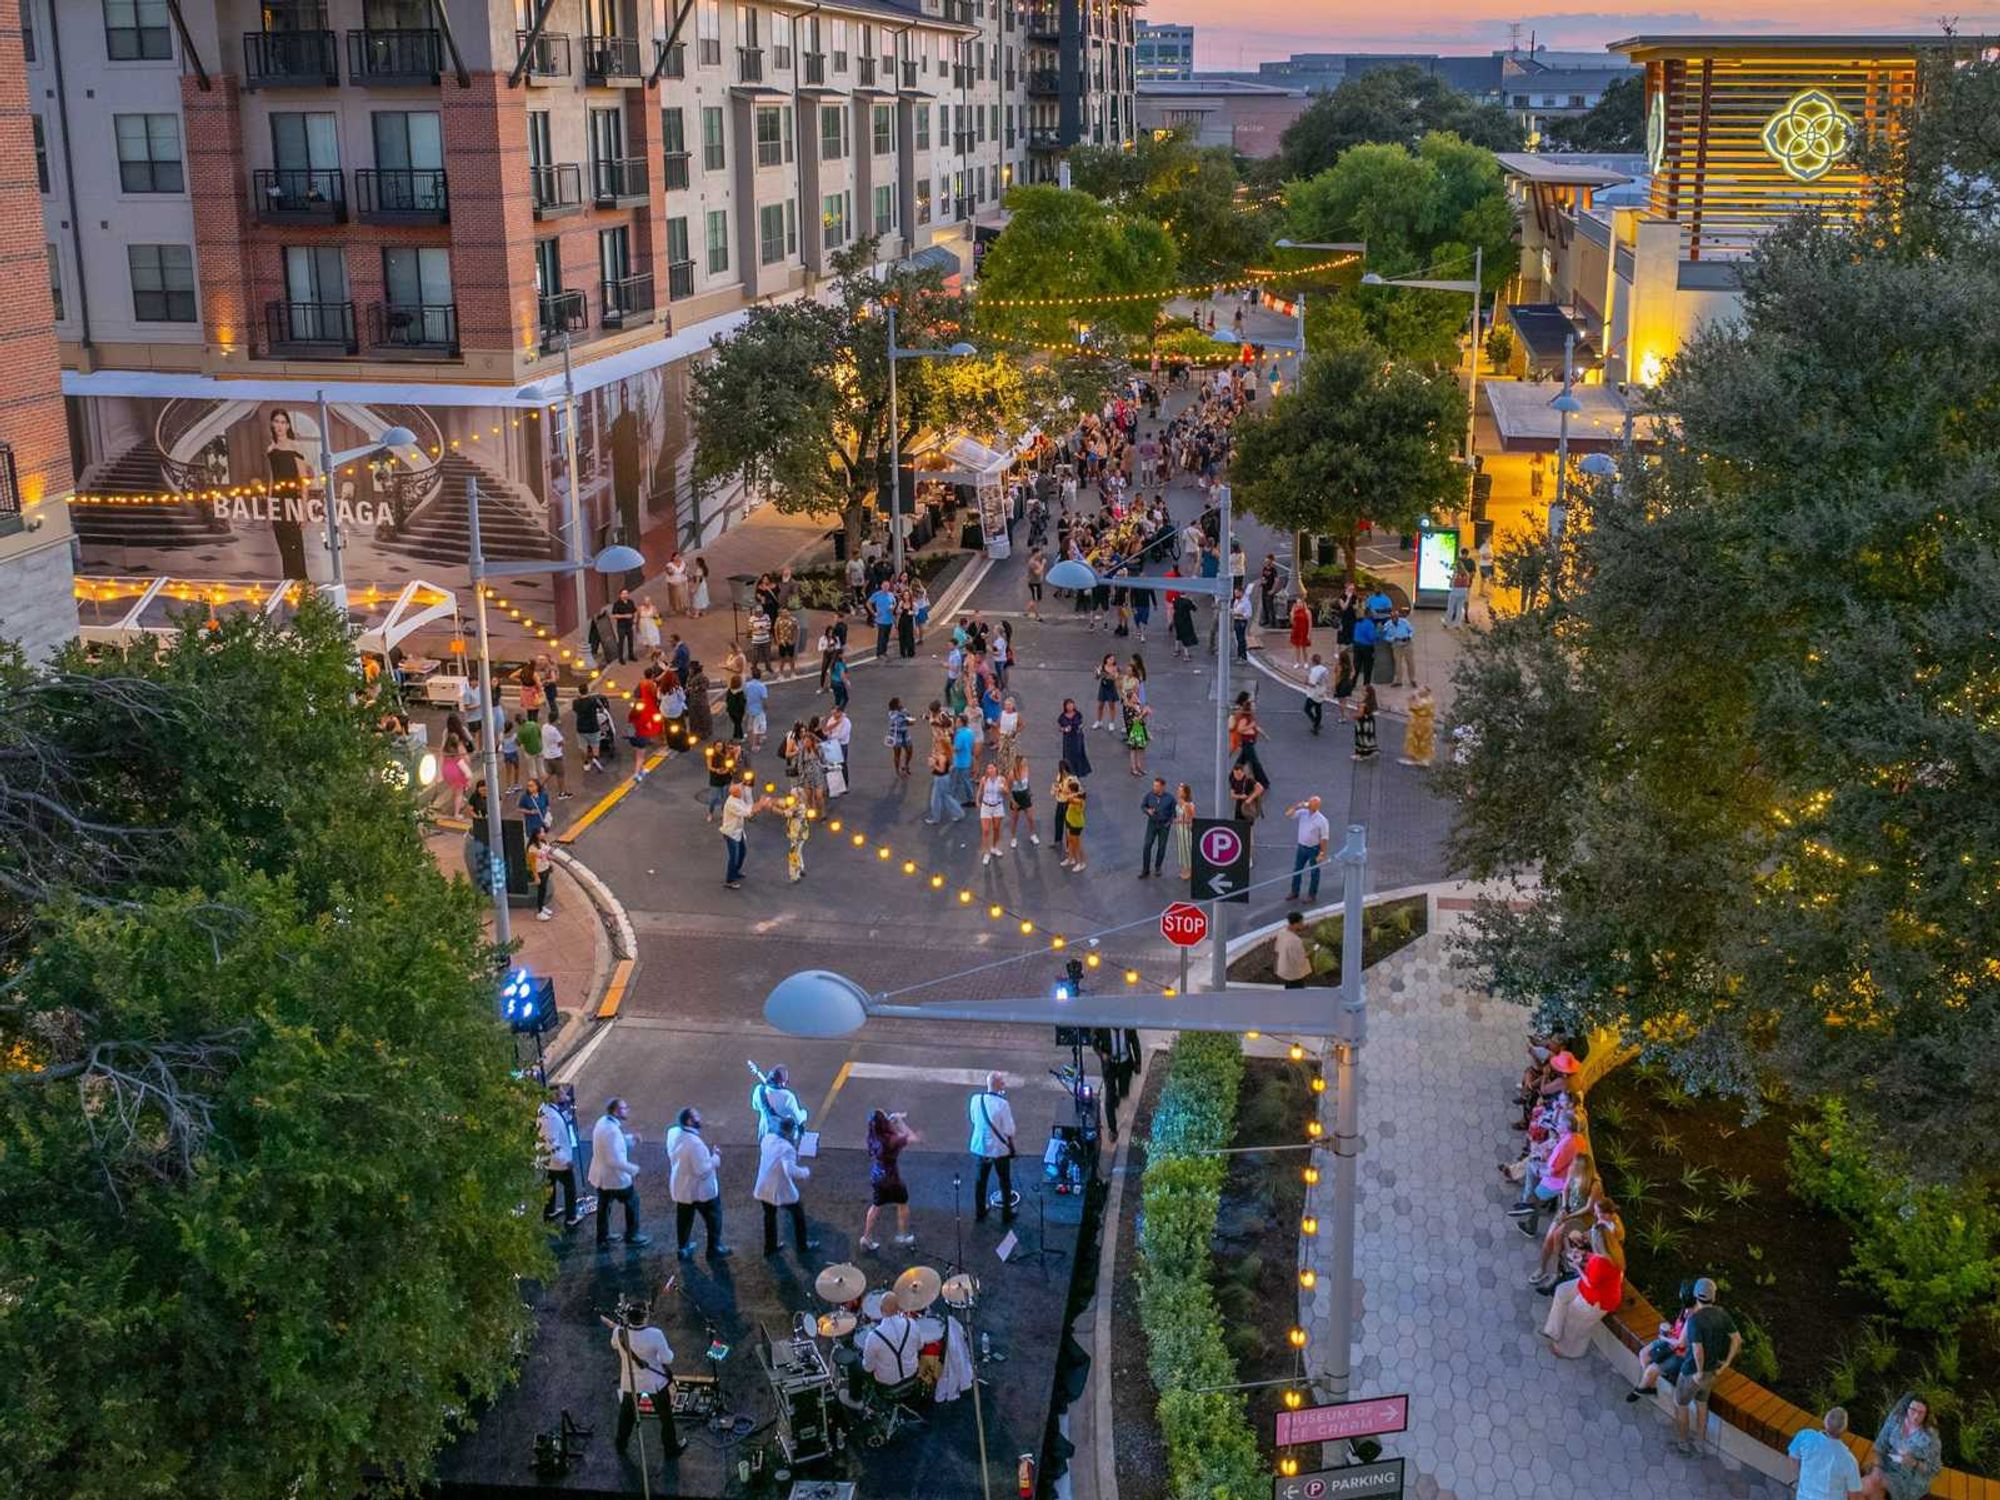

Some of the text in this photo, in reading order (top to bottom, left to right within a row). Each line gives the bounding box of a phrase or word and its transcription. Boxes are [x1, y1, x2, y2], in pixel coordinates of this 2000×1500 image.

[213, 496, 394, 526] BALENCAGA
[1213, 833, 1232, 859] P
[1165, 916, 1204, 933] STOP
[1285, 1406, 1374, 1425] MUSEUM OF
[1284, 1420, 1372, 1439] ICE CREAM
[1311, 1472, 1395, 1495] P PARKING
